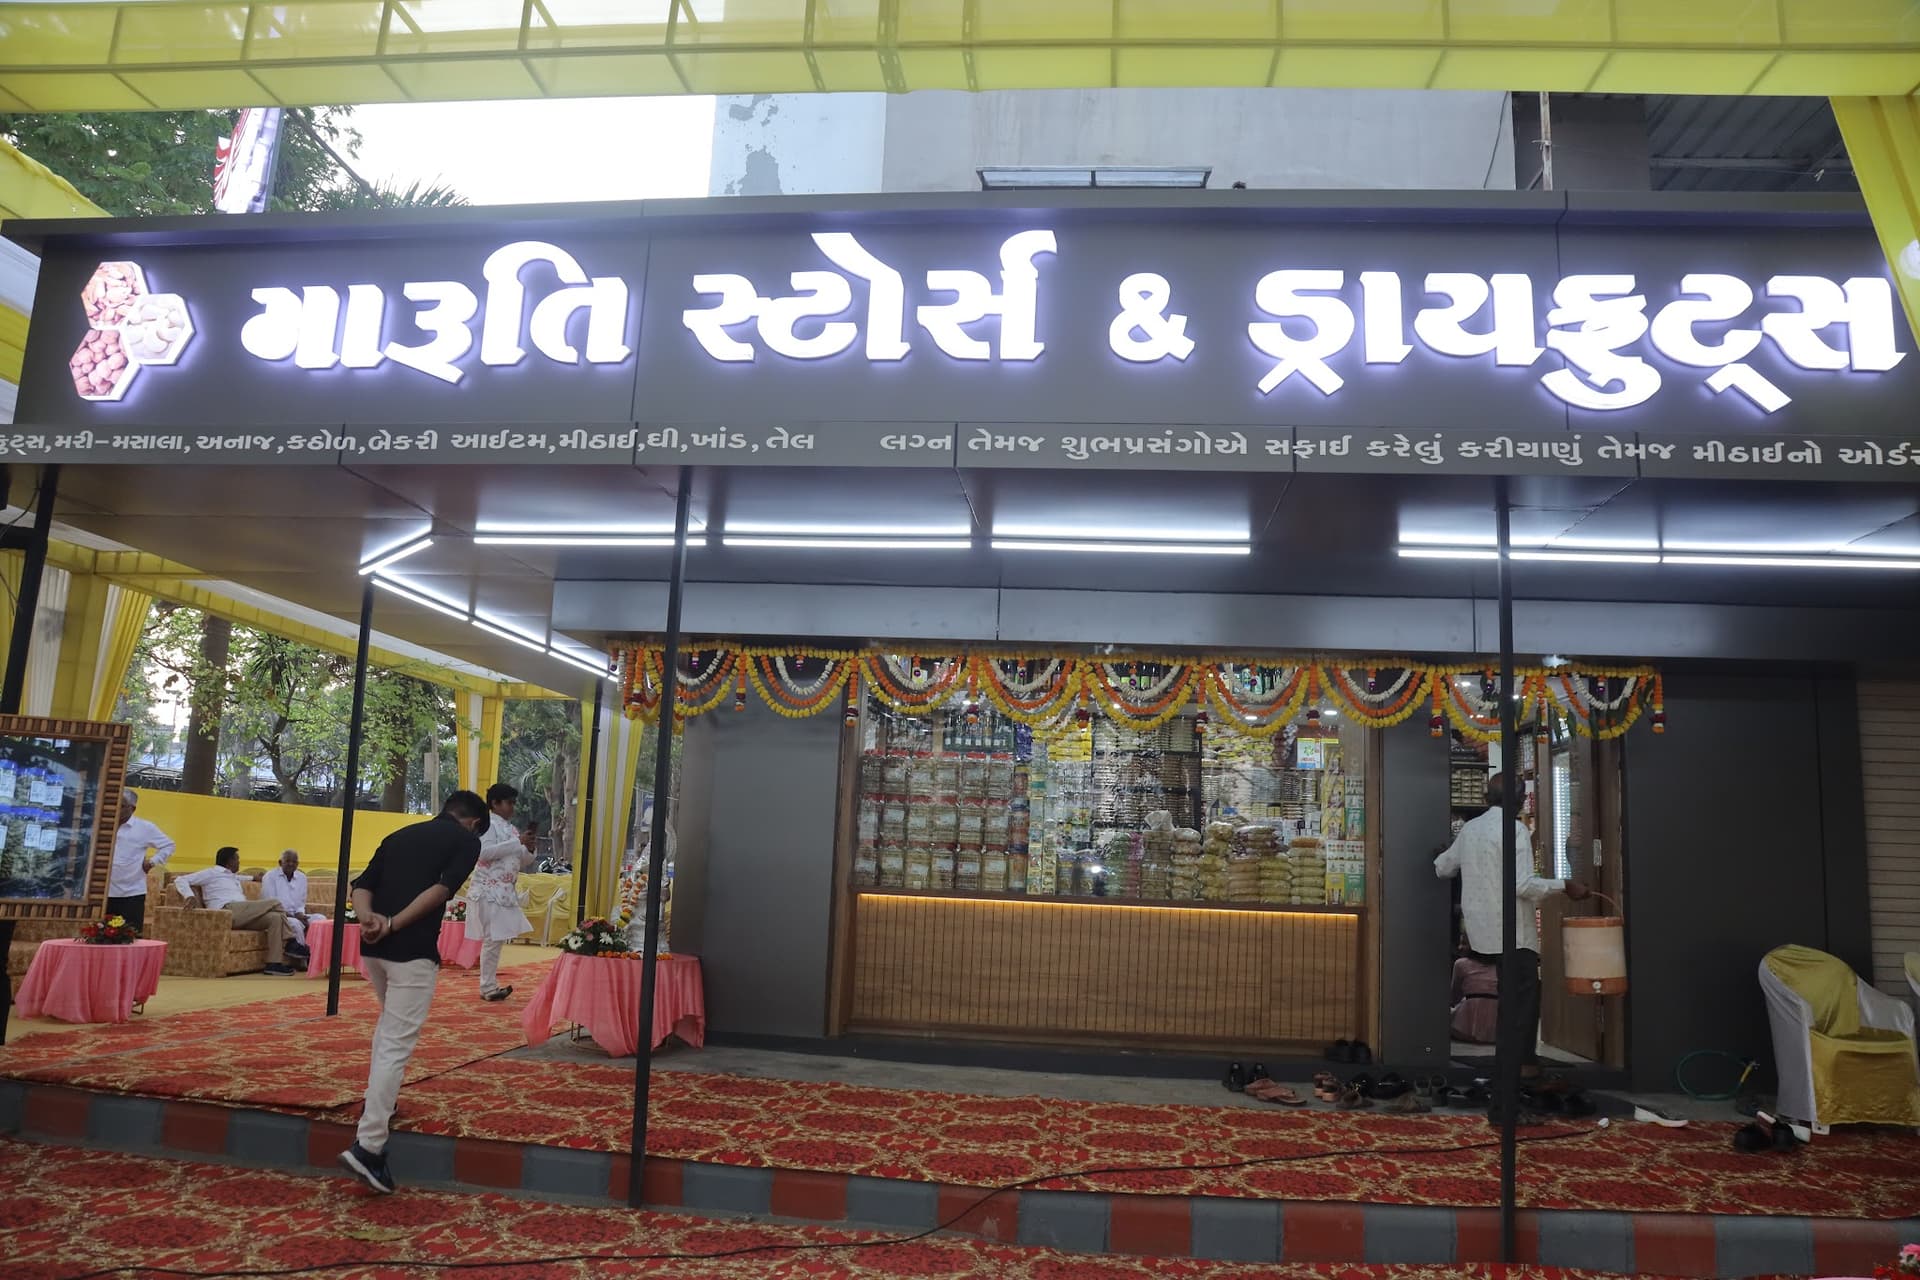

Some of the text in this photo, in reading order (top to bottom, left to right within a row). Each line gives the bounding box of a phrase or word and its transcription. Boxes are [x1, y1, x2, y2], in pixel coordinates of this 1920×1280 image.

[240, 240, 632, 385] મારૂતિ
[681, 230, 1058, 363] સ્ટોર્સ
[1108, 271, 1196, 363] &
[367, 429, 439, 451] બેકરી
[765, 426, 815, 450] તેલ
[879, 433, 952, 451] લગ્ન
[967, 428, 1046, 452] તેમજ
[1060, 429, 1249, 461] શુભપ્રસંગોએ
[1365, 432, 1445, 465] કરેલું
[1457, 434, 1585, 466] કરીયાણું
[1597, 435, 1678, 461] તેમજ
[1692, 439, 1823, 465] મીઠાઈનો
